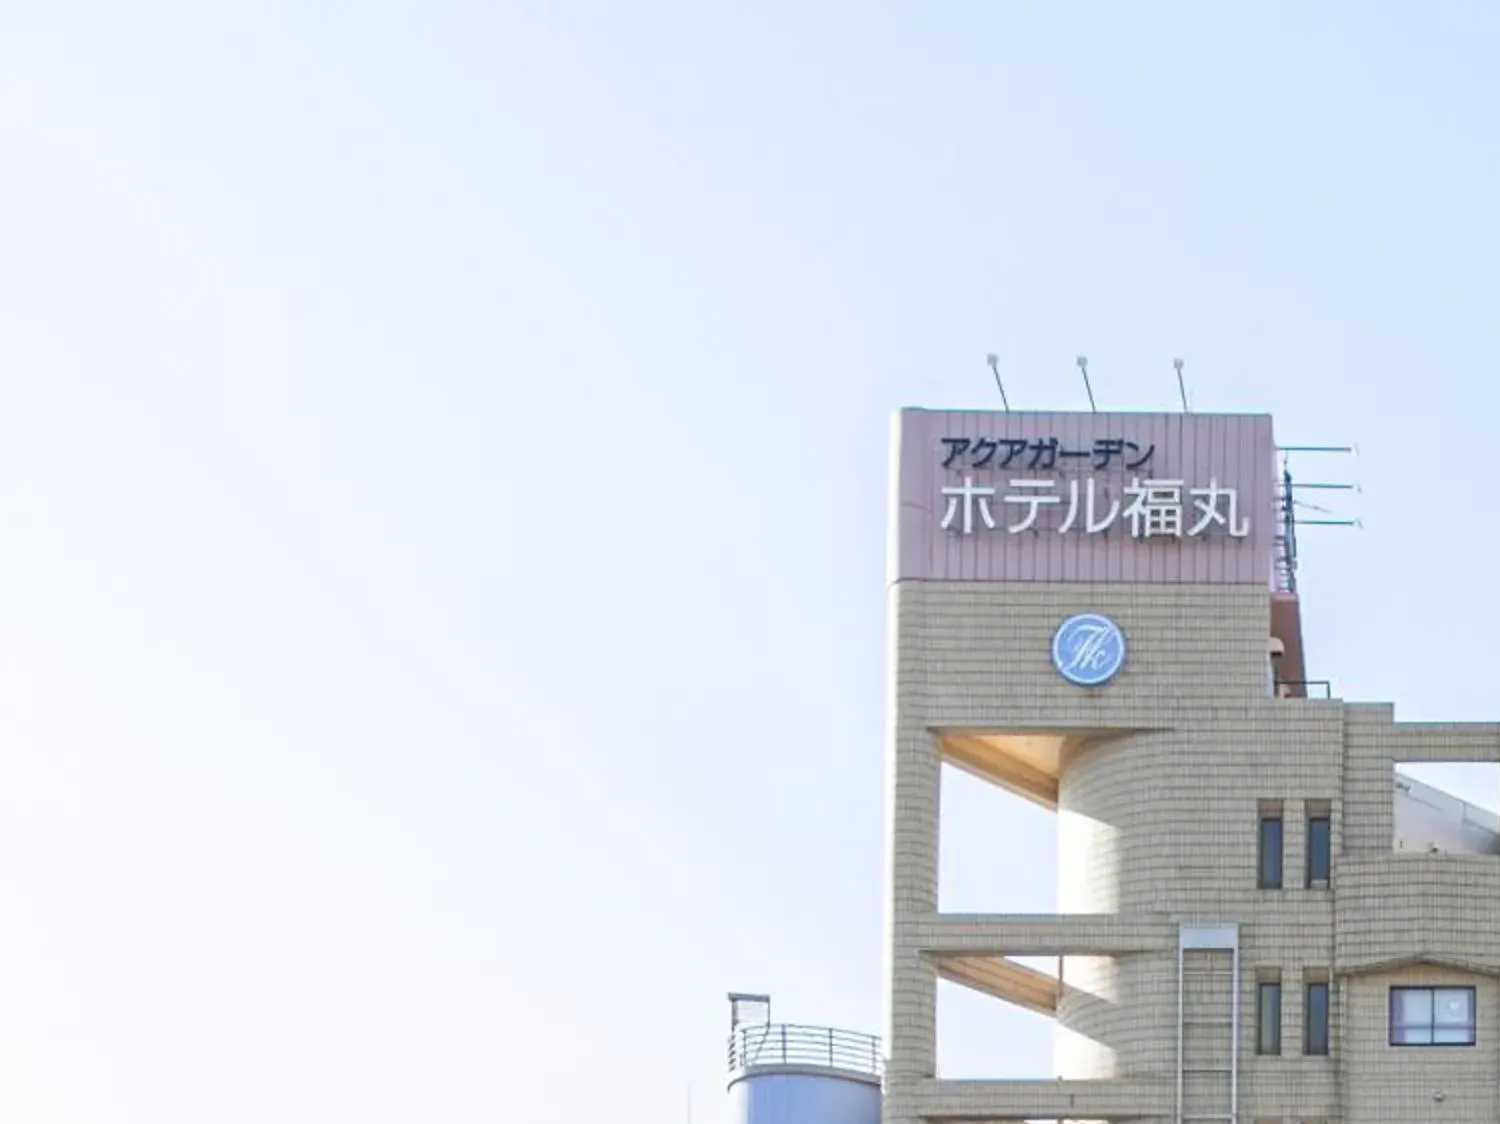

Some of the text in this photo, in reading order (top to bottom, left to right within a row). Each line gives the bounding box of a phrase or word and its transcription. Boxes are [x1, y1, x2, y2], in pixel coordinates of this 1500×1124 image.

[941, 437, 1155, 470] アクアガーデン
[940, 476, 1250, 538] ホテル福丸
